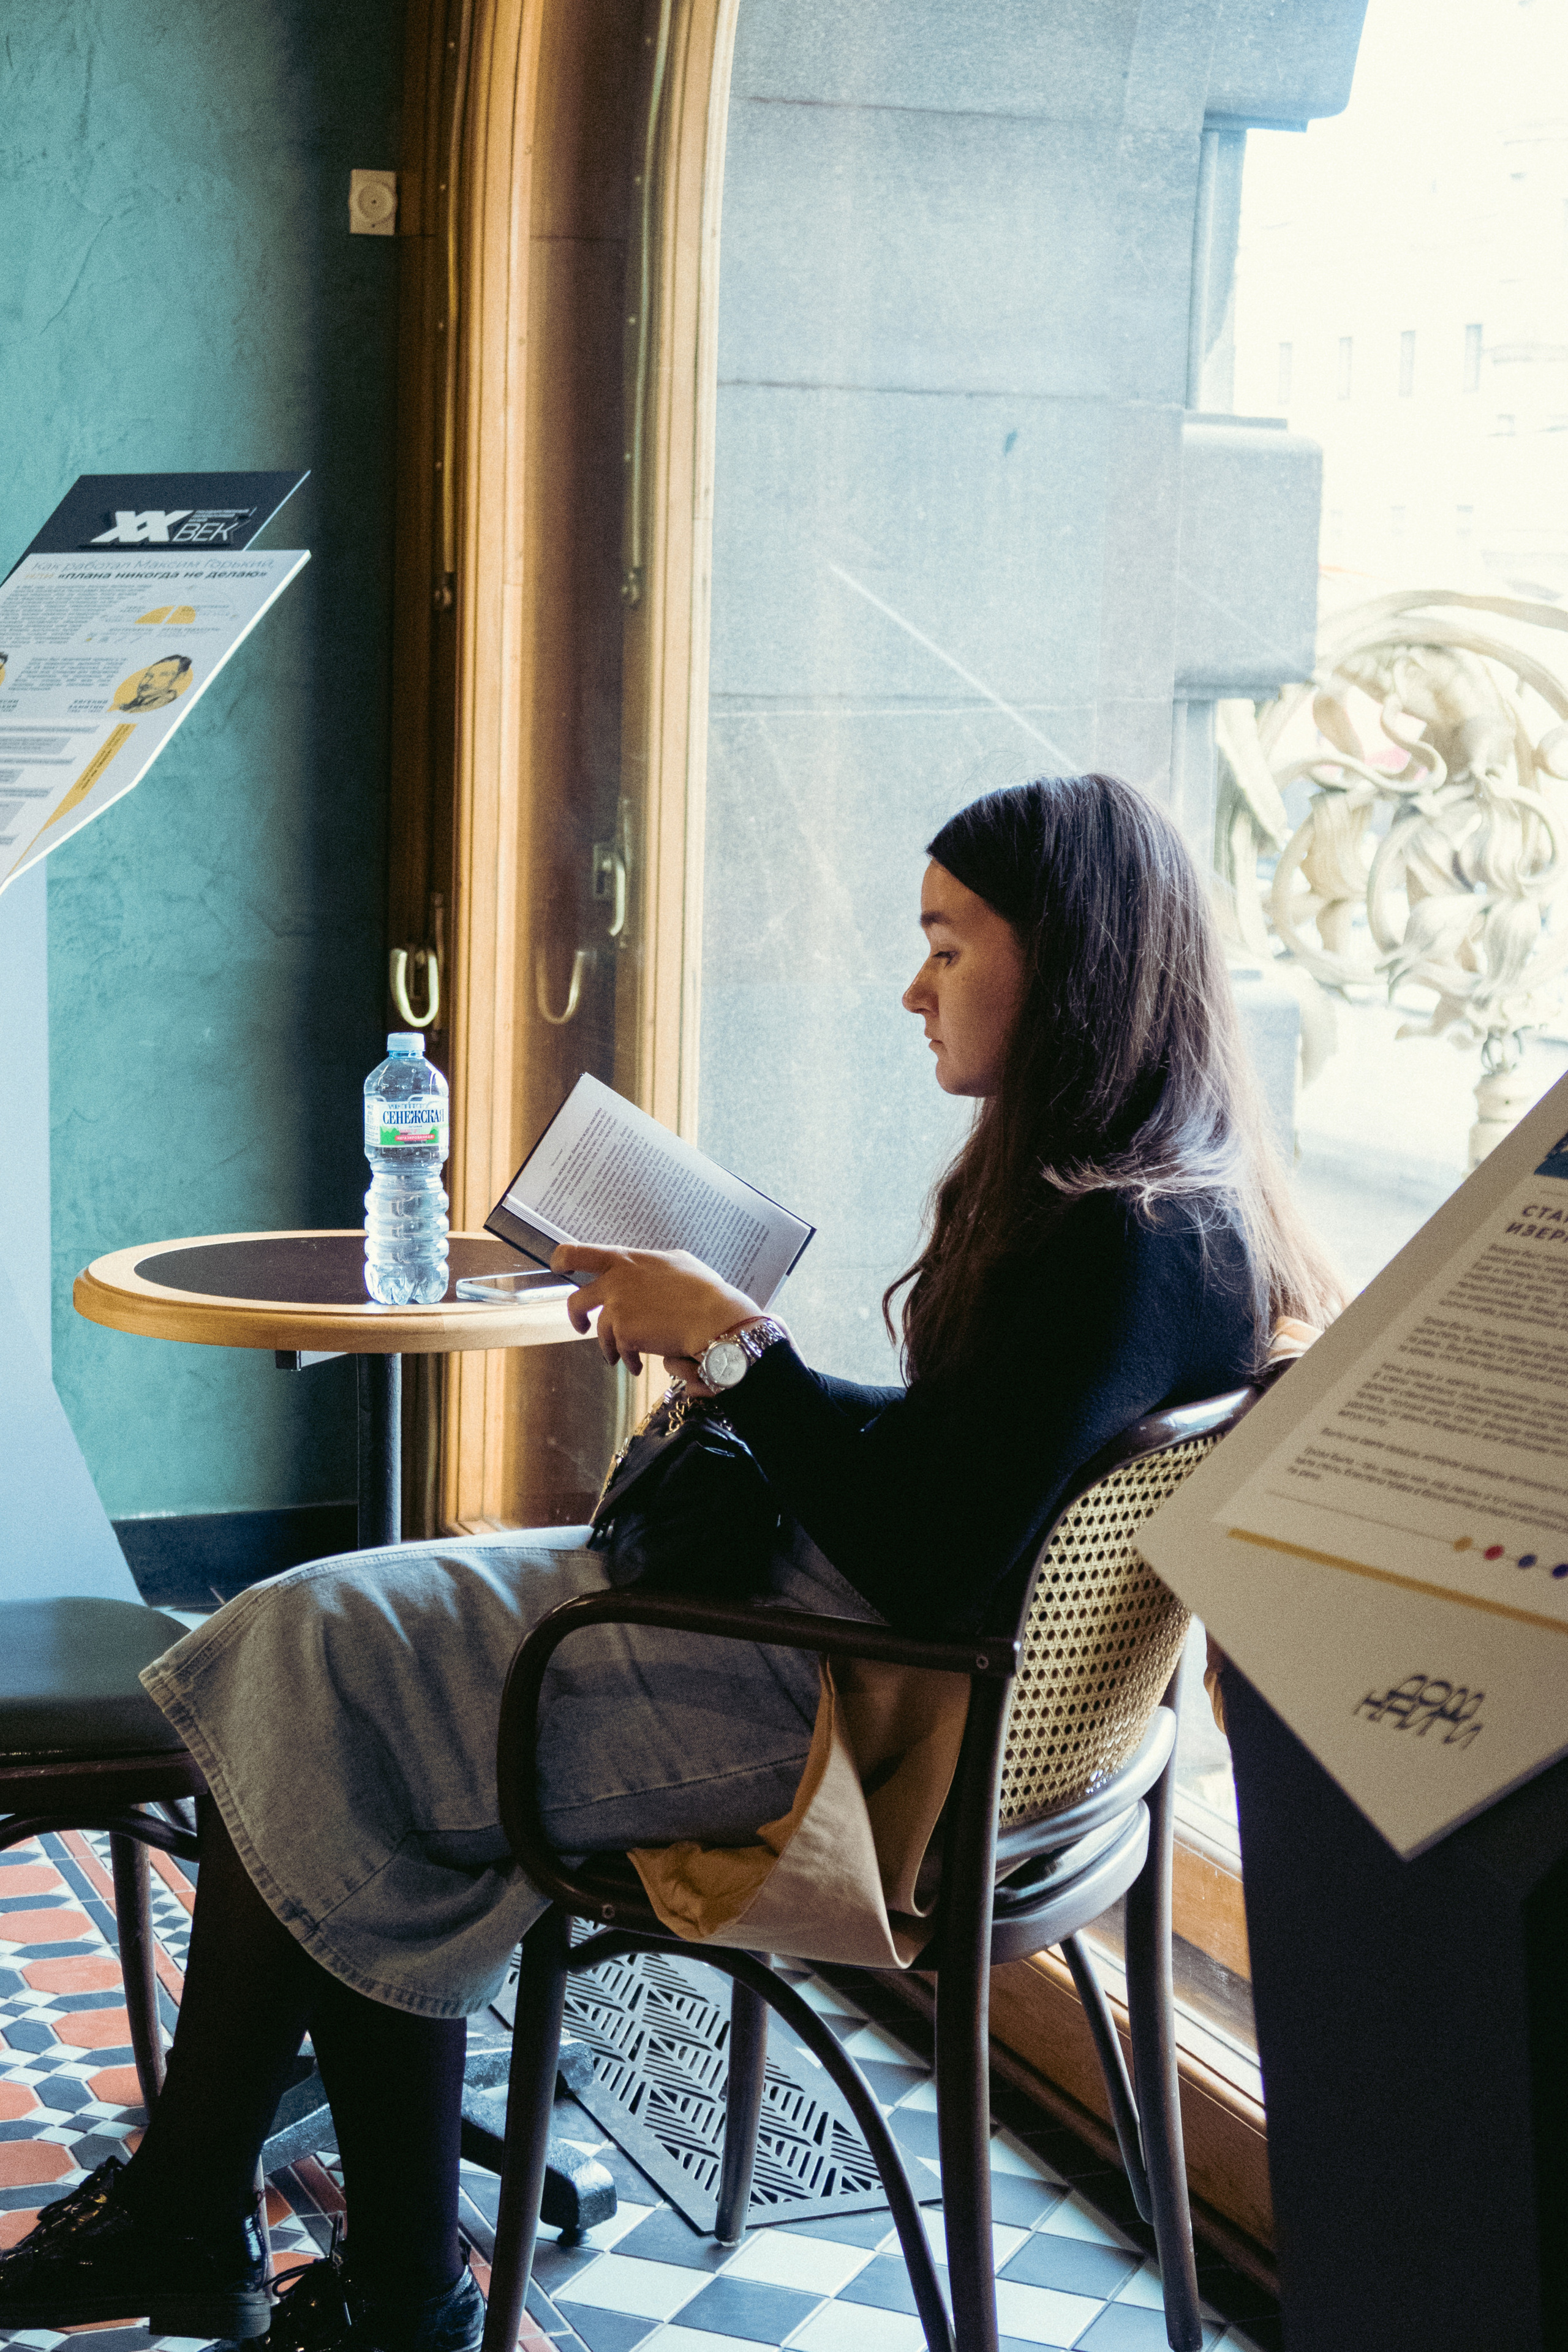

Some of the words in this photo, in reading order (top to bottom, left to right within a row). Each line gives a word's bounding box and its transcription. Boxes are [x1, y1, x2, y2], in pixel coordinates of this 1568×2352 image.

[172, 522, 238, 541] ВЕК
[32, 562, 59, 570] Как
[62, 560, 131, 571] работал
[134, 559, 201, 569] Максим
[115, 571, 179, 580] никогда
[204, 571, 268, 580] делаю»
[383, 1109, 444, 1125] СЕНЕЖСКАЯ
